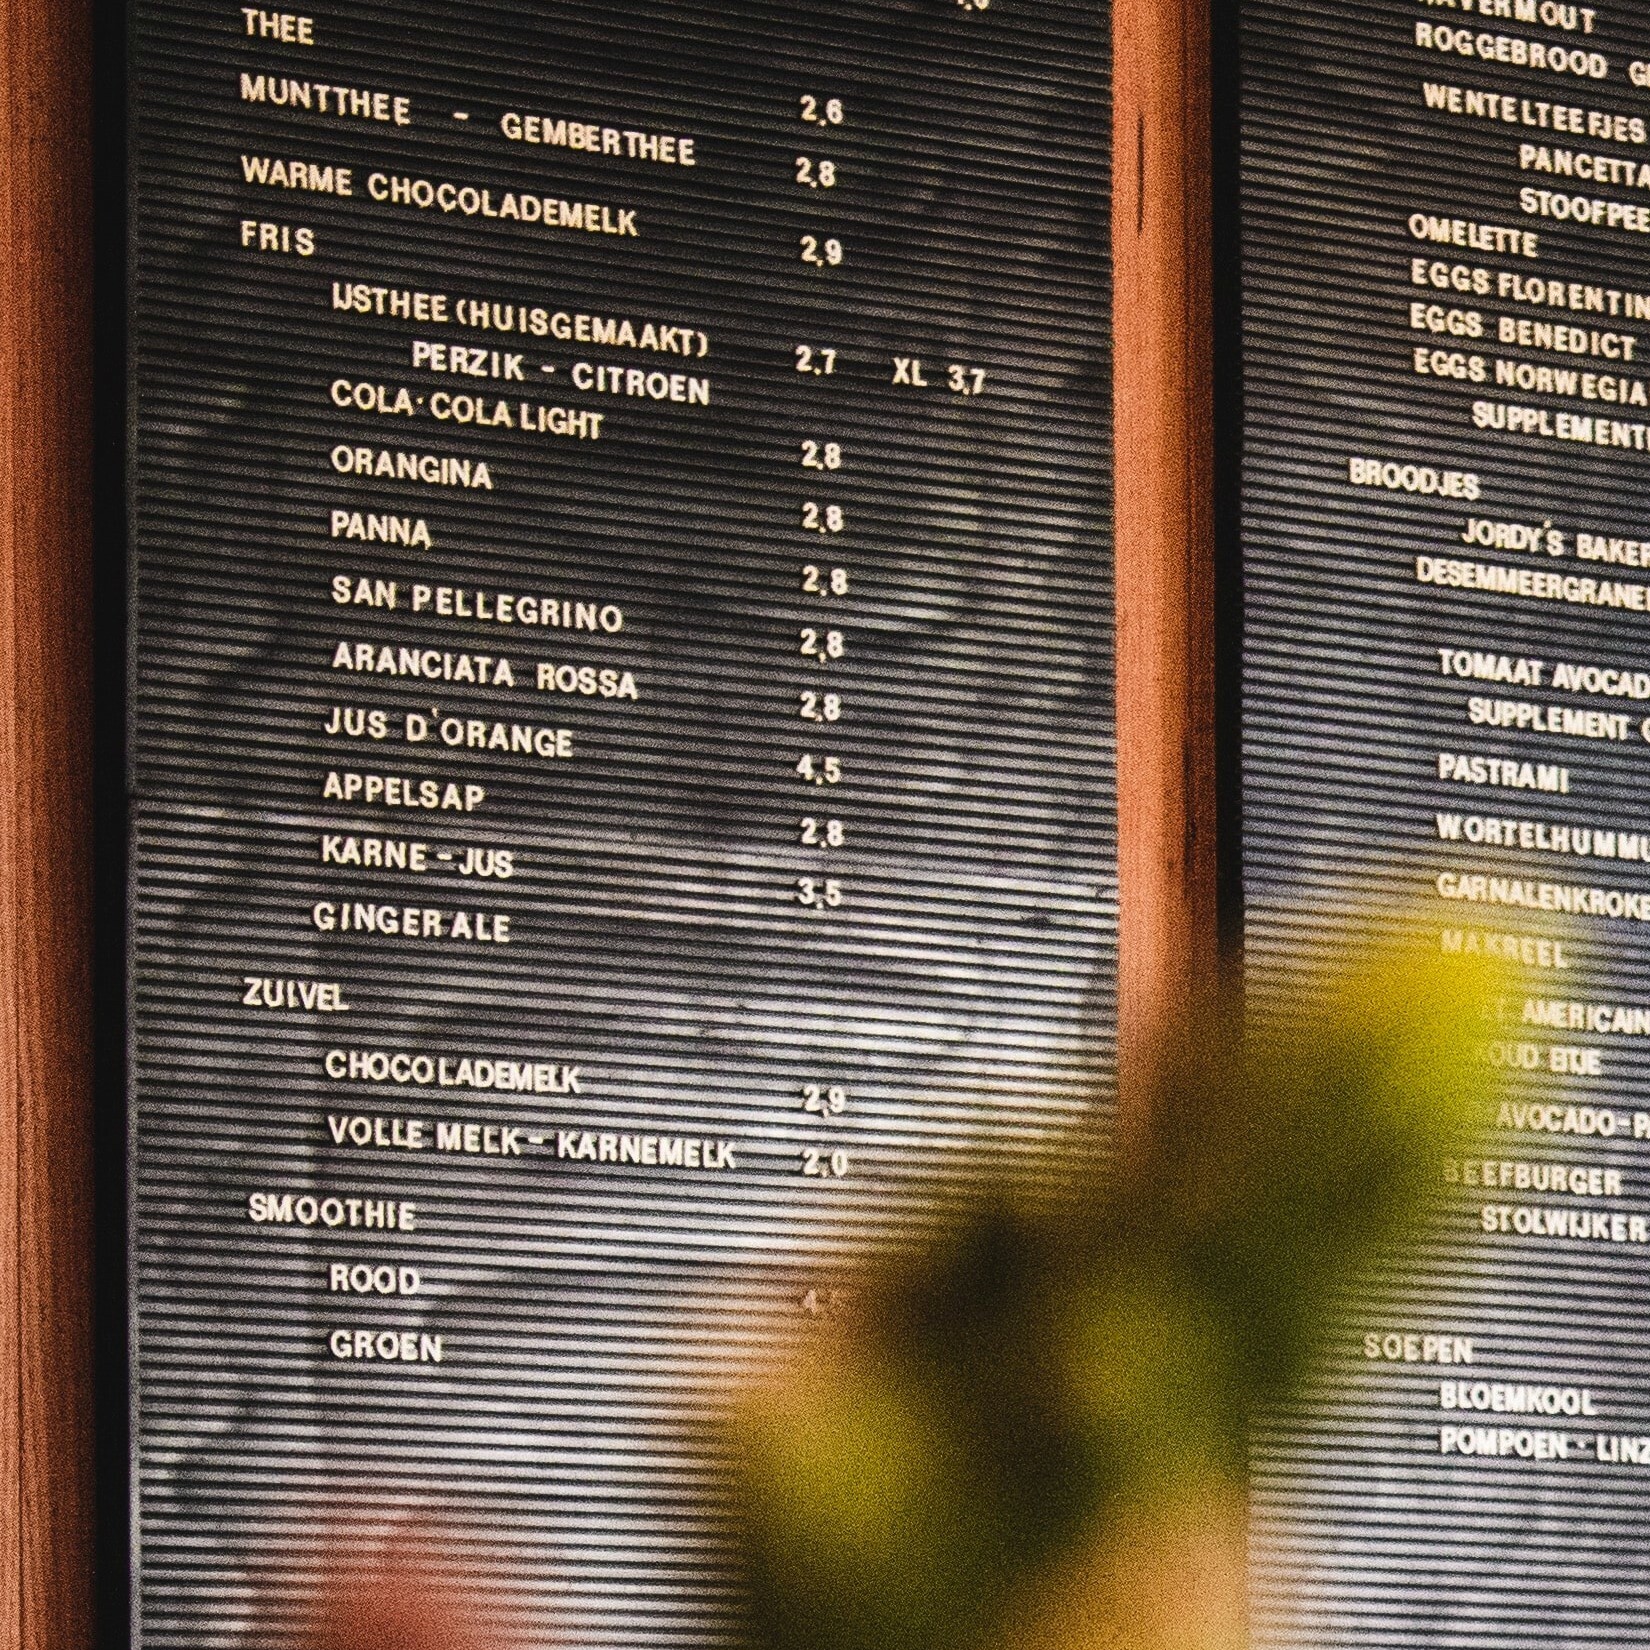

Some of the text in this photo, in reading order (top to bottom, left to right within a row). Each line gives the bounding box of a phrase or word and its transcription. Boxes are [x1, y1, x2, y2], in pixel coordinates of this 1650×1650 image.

[245, 8, 314, 45] THEE
[1418, 0, 1596, 34] ERMOUT
[1415, 22, 1608, 79] ROGGEBROOD
[240, 72, 411, 126] MUNTTHEE
[501, 112, 695, 165] GEMBERTHEE
[1423, 82, 1647, 144] WENTELTEEFJES
[241, 155, 352, 197] WARME
[368, 170, 638, 237] CHOCOLADEMELK
[241, 219, 316, 257] FRIS
[1409, 213, 1538, 258] OMELETTE
[1411, 259, 1491, 296] EGGS
[456, 298, 709, 359] (HUISGEMAAKT)
[892, 357, 928, 388] XL
[1410, 303, 1483, 338] EGGS
[1498, 316, 1637, 361] BENEDICT
[412, 340, 526, 381] PERZIK
[571, 362, 711, 407] CITROEN
[1413, 347, 1485, 382] EGGS
[430, 392, 513, 428] COLA
[520, 403, 605, 441] LIGHT
[331, 445, 493, 491] ORANGINA
[1349, 457, 1480, 499] BROODJES
[331, 510, 432, 549] PANNA
[1461, 518, 1565, 557] JORDY'S
[332, 575, 397, 609] SAN
[412, 583, 623, 634] PELLEGRINO
[333, 641, 515, 690] ARANCIATA
[536, 663, 639, 701] ROSSA
[1438, 648, 1543, 687] TOMAAT
[324, 707, 388, 740] JUS
[404, 708, 574, 758] D'ORANGE
[1467, 696, 1630, 740] SUPPLEMENT
[323, 773, 485, 814] APPELSAP
[1438, 753, 1570, 793] PASTRAMI
[1441, 930, 1569, 968] MAKREEL
[243, 975, 349, 1013] ZUIVEL
[324, 1050, 582, 1097] CHOCOLADEMELK
[328, 1116, 425, 1152] VOLLE
[556, 1130, 737, 1171] KARNEMELK
[1445, 1159, 1623, 1196] BEEFBURGER
[247, 1191, 416, 1233] SMOOTHIE
[1481, 1206, 1649, 1243] STOLWIJKER
[329, 1263, 421, 1298] ROOD
[329, 1329, 443, 1366] GROEN
[1364, 1333, 1473, 1364] SOEPEN
[1440, 1381, 1597, 1416] BLOEMKOOL
[1440, 1426, 1568, 1460] POMPOEN
